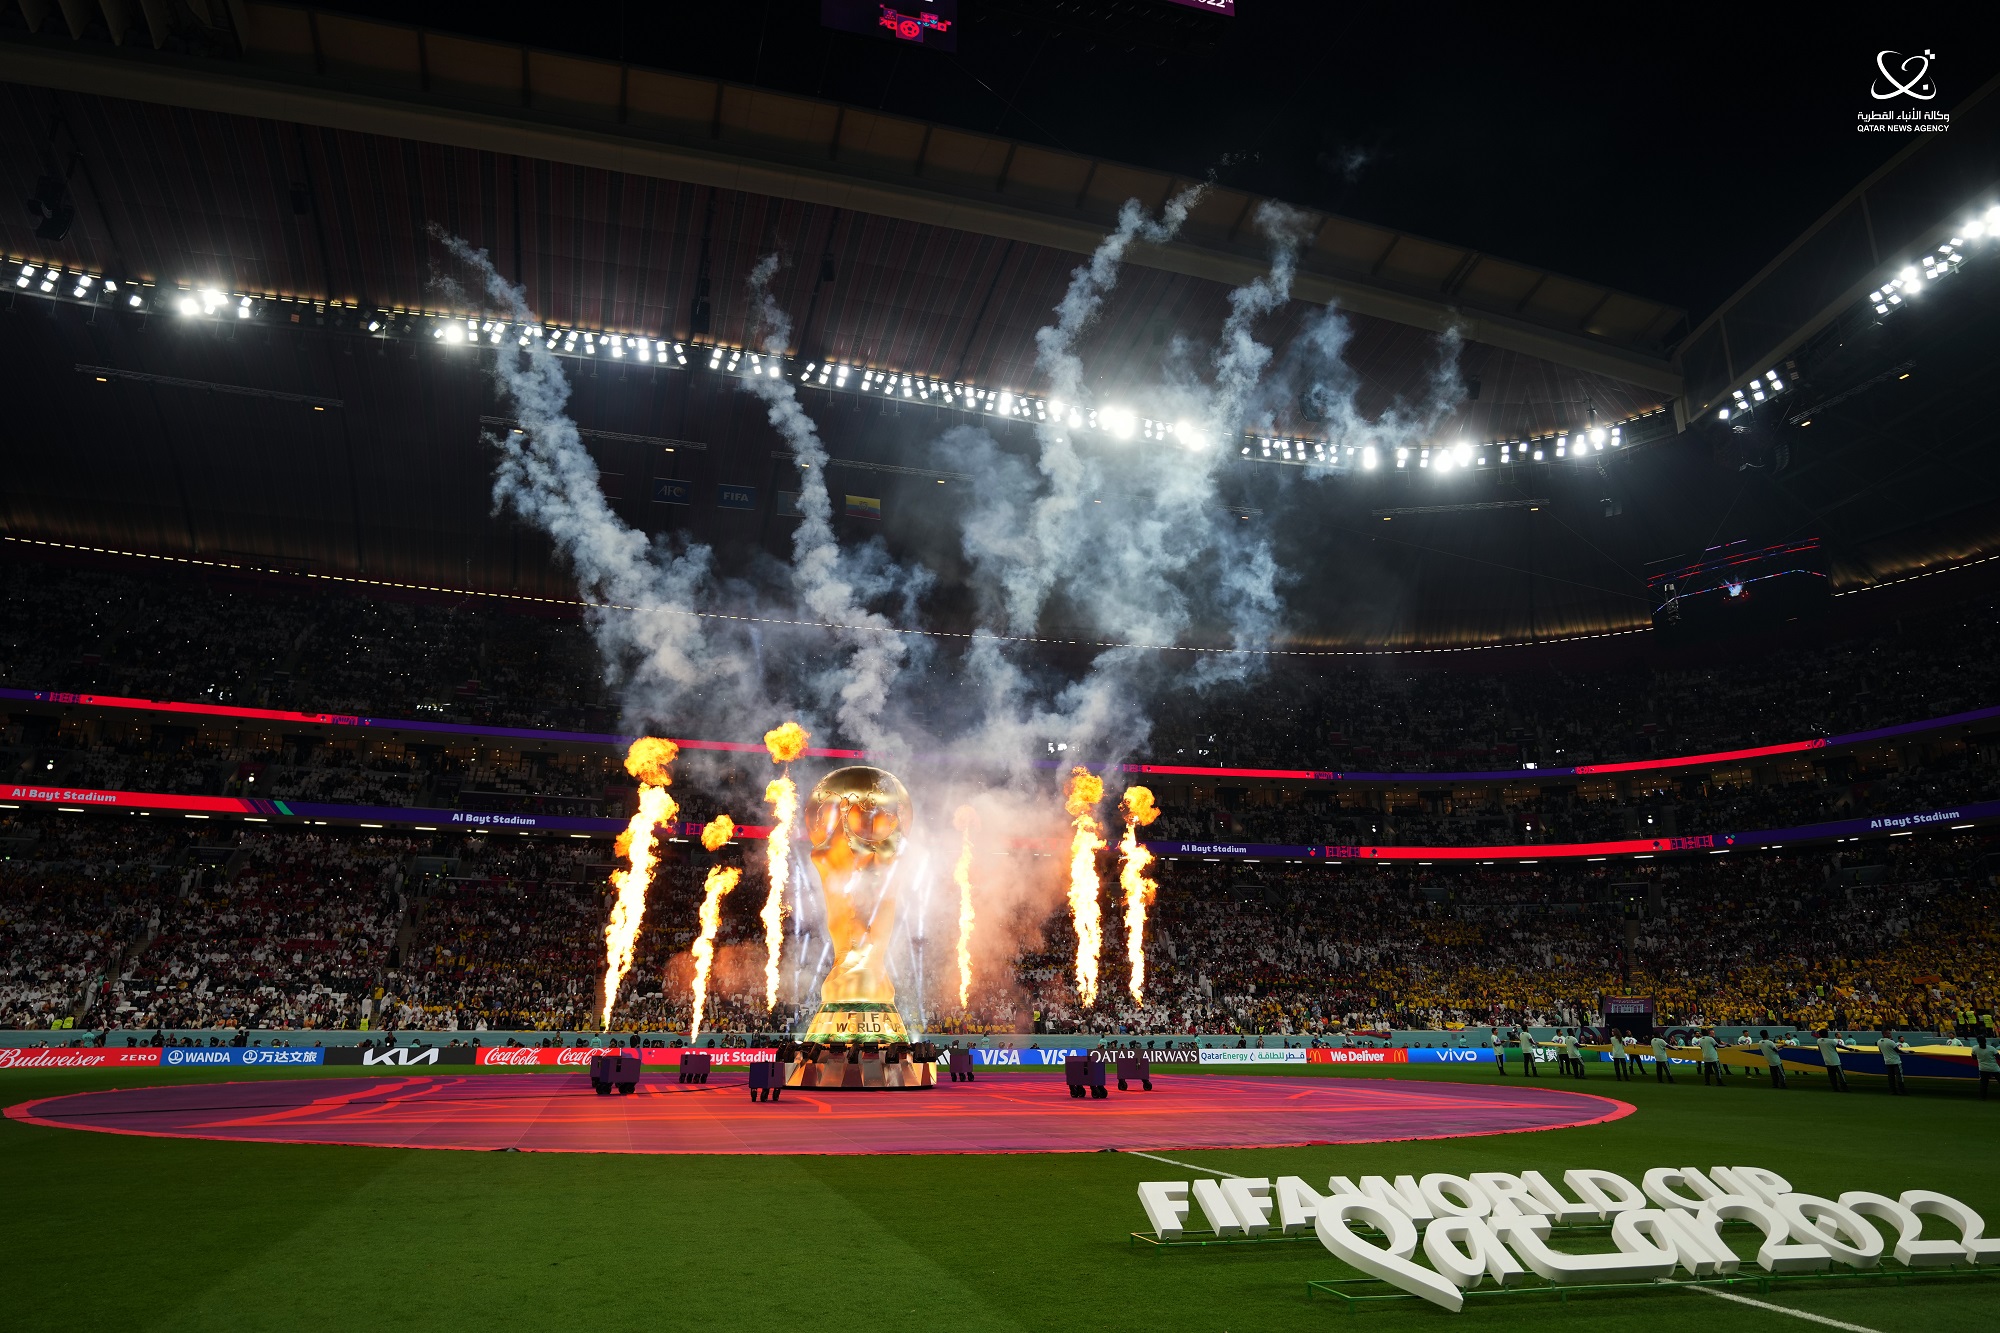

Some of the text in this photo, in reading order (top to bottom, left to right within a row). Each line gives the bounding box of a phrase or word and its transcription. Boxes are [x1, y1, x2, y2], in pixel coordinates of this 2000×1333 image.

[658, 485, 686, 497] AFC
[723, 491, 749, 502] FIFA
[12, 788, 117, 802] Al Bayt Stadium
[452, 813, 536, 825] Al Bayt Stadium
[1870, 811, 1960, 828] Al Bayt Stadium
[1181, 844, 1247, 854] Al Bayt Stadium
[848, 1012, 892, 1022] FIFA
[836, 1022, 881, 1033] WORLD
[0, 1048, 105, 1069] Budweiser
[185, 1052, 231, 1063] WANDA
[259, 1050, 318, 1063] 万达文旅
[732, 1050, 777, 1062] Stadiu
[978, 1049, 1021, 1065] VISA
[1090, 1050, 1197, 1063] QATAR AIRWAYS
[1201, 1052, 1248, 1061] QatarEnergy
[1330, 1049, 1385, 1062] We Deliver
[1436, 1048, 1478, 1062] vivo
[1137, 1176, 1325, 1240] FIFA
[1328, 1170, 1647, 1231] WORLD
[1315, 1189, 2000, 1313] Qatar 2022
